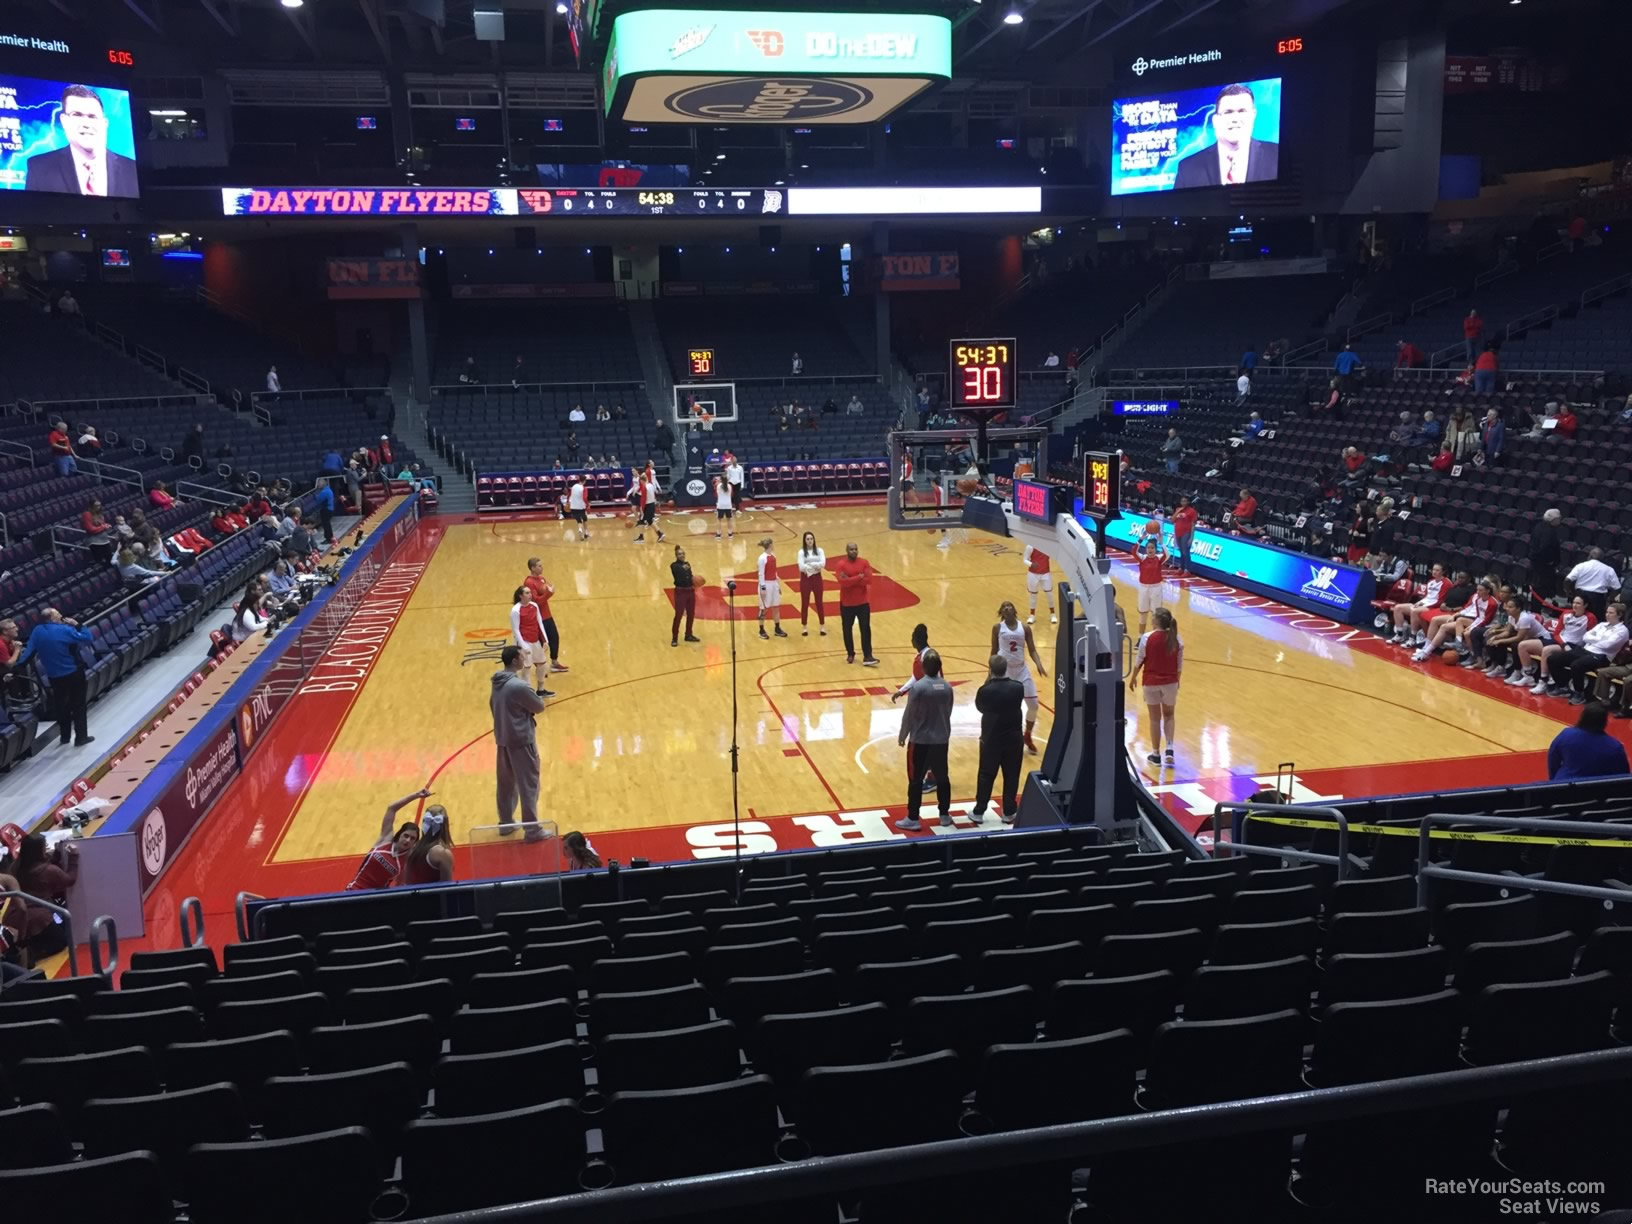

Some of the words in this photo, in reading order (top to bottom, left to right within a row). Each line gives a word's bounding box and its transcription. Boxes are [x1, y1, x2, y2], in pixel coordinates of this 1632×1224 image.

[0, 34, 28, 47] emier
[31, 38, 70, 54] Health
[1279, 39, 1302, 53] 6:05
[108, 50, 133, 66] 6:05
[1150, 57, 1187, 70] Premier
[1188, 50, 1222, 64] Health
[251, 191, 376, 212] DAYTON
[379, 191, 490, 212] FLYERS
[564, 198, 572, 210] 0
[588, 200, 594, 209] 4
[606, 200, 613, 209] 0
[638, 192, 674, 205] 54:38
[699, 199, 706, 208] 0
[718, 199, 724, 208] 4
[737, 198, 745, 210] 0
[690, 352, 711, 360] 54:37
[956, 346, 1008, 366] 54:37
[694, 360, 709, 372] 30
[965, 367, 1000, 400] 30
[689, 482, 704, 494] Kroger
[1018, 484, 1046, 503] DAYTON
[1096, 482, 1108, 505] 30
[1018, 498, 1044, 516] FLYERS
[1190, 538, 1223, 560] SMILE!
[1301, 587, 1319, 597] Superior
[1319, 592, 1335, 601] Dental
[1184, 586, 1383, 641] DAYTON
[298, 598, 405, 695] BLACKBURN
[370, 561, 426, 595] COURT
[1009, 640, 1018, 652] 2
[252, 684, 273, 732] PNC
[196, 752, 218, 788] Premier
[218, 732, 237, 762] Health
[144, 824, 164, 863] Kroger
